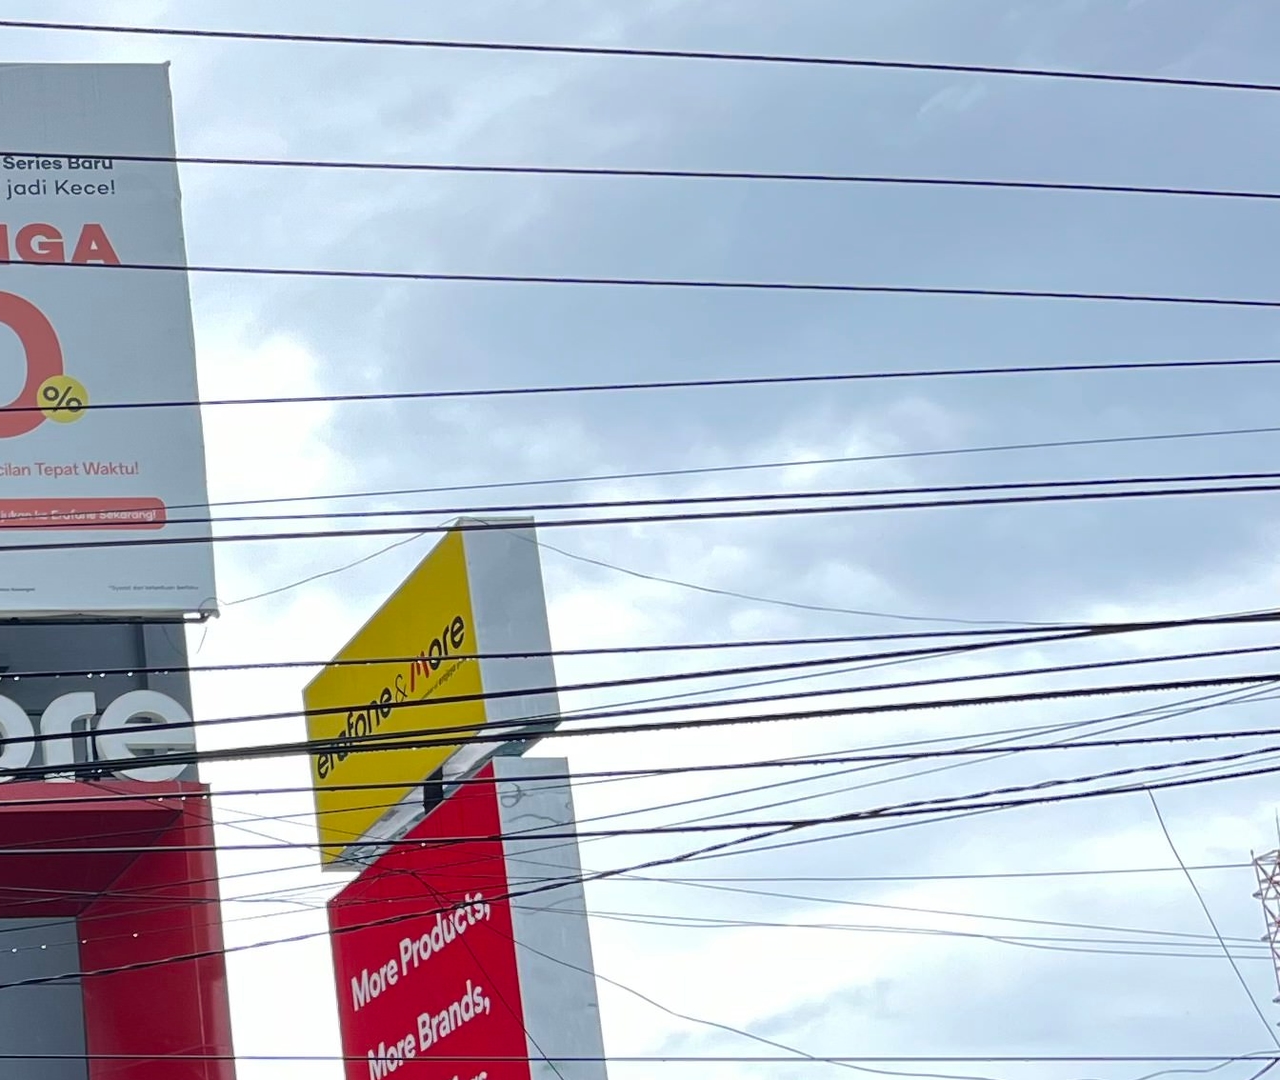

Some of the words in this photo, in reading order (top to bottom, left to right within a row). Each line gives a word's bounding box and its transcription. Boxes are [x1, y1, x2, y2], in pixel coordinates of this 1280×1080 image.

[3, 155, 63, 171] Series
[68, 156, 114, 171] Baru
[6, 179, 47, 200] jadi
[55, 179, 116, 196] Kece!
[35, 461, 80, 480] Tepat
[83, 460, 140, 476] Waktu!
[316, 687, 393, 780] erafone
[394, 673, 408, 704] &
[350, 959, 398, 1012] More
[400, 891, 491, 977] Products,
[416, 979, 491, 1048] Brands,
